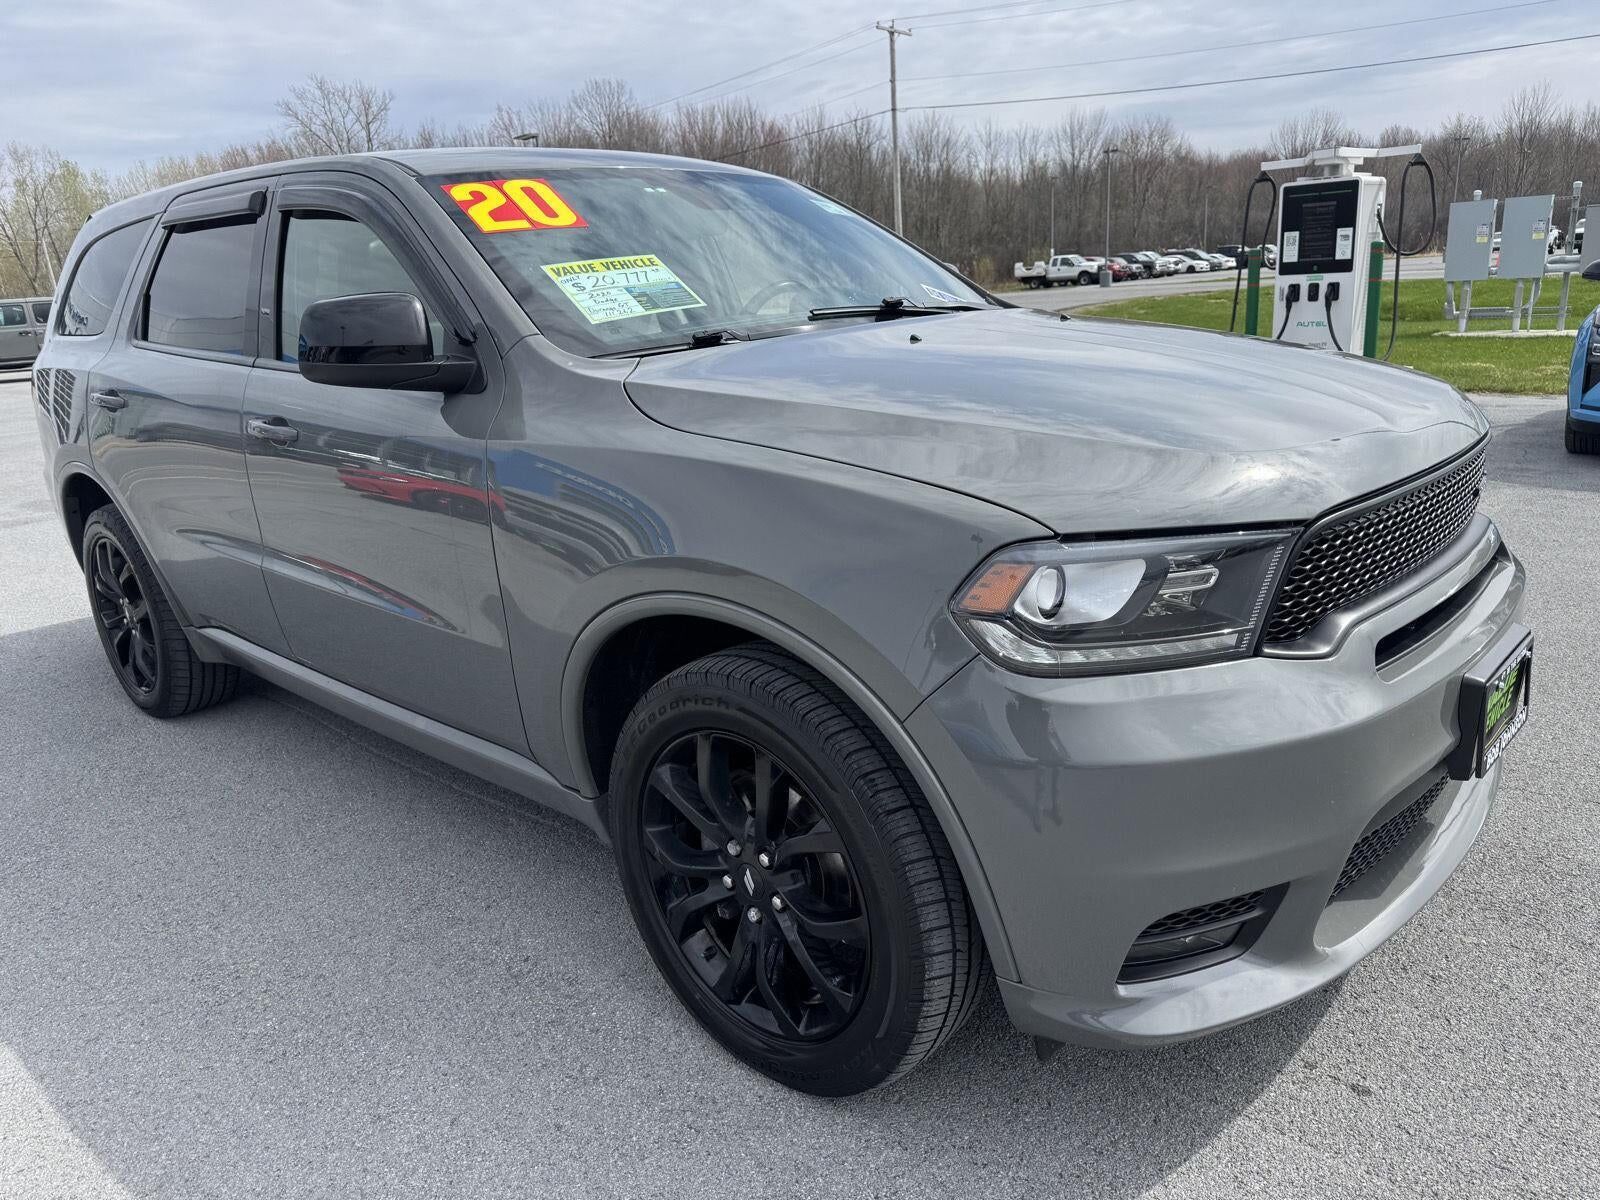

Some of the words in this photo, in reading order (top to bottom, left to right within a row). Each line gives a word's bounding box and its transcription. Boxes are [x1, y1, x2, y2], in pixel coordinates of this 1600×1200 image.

[450, 179, 577, 232] 20
[551, 262, 599, 277] VALUE
[600, 257, 659, 273] VEHICLE
[561, 275, 580, 285] ONLY
[1296, 320, 1327, 328] AUTEL
